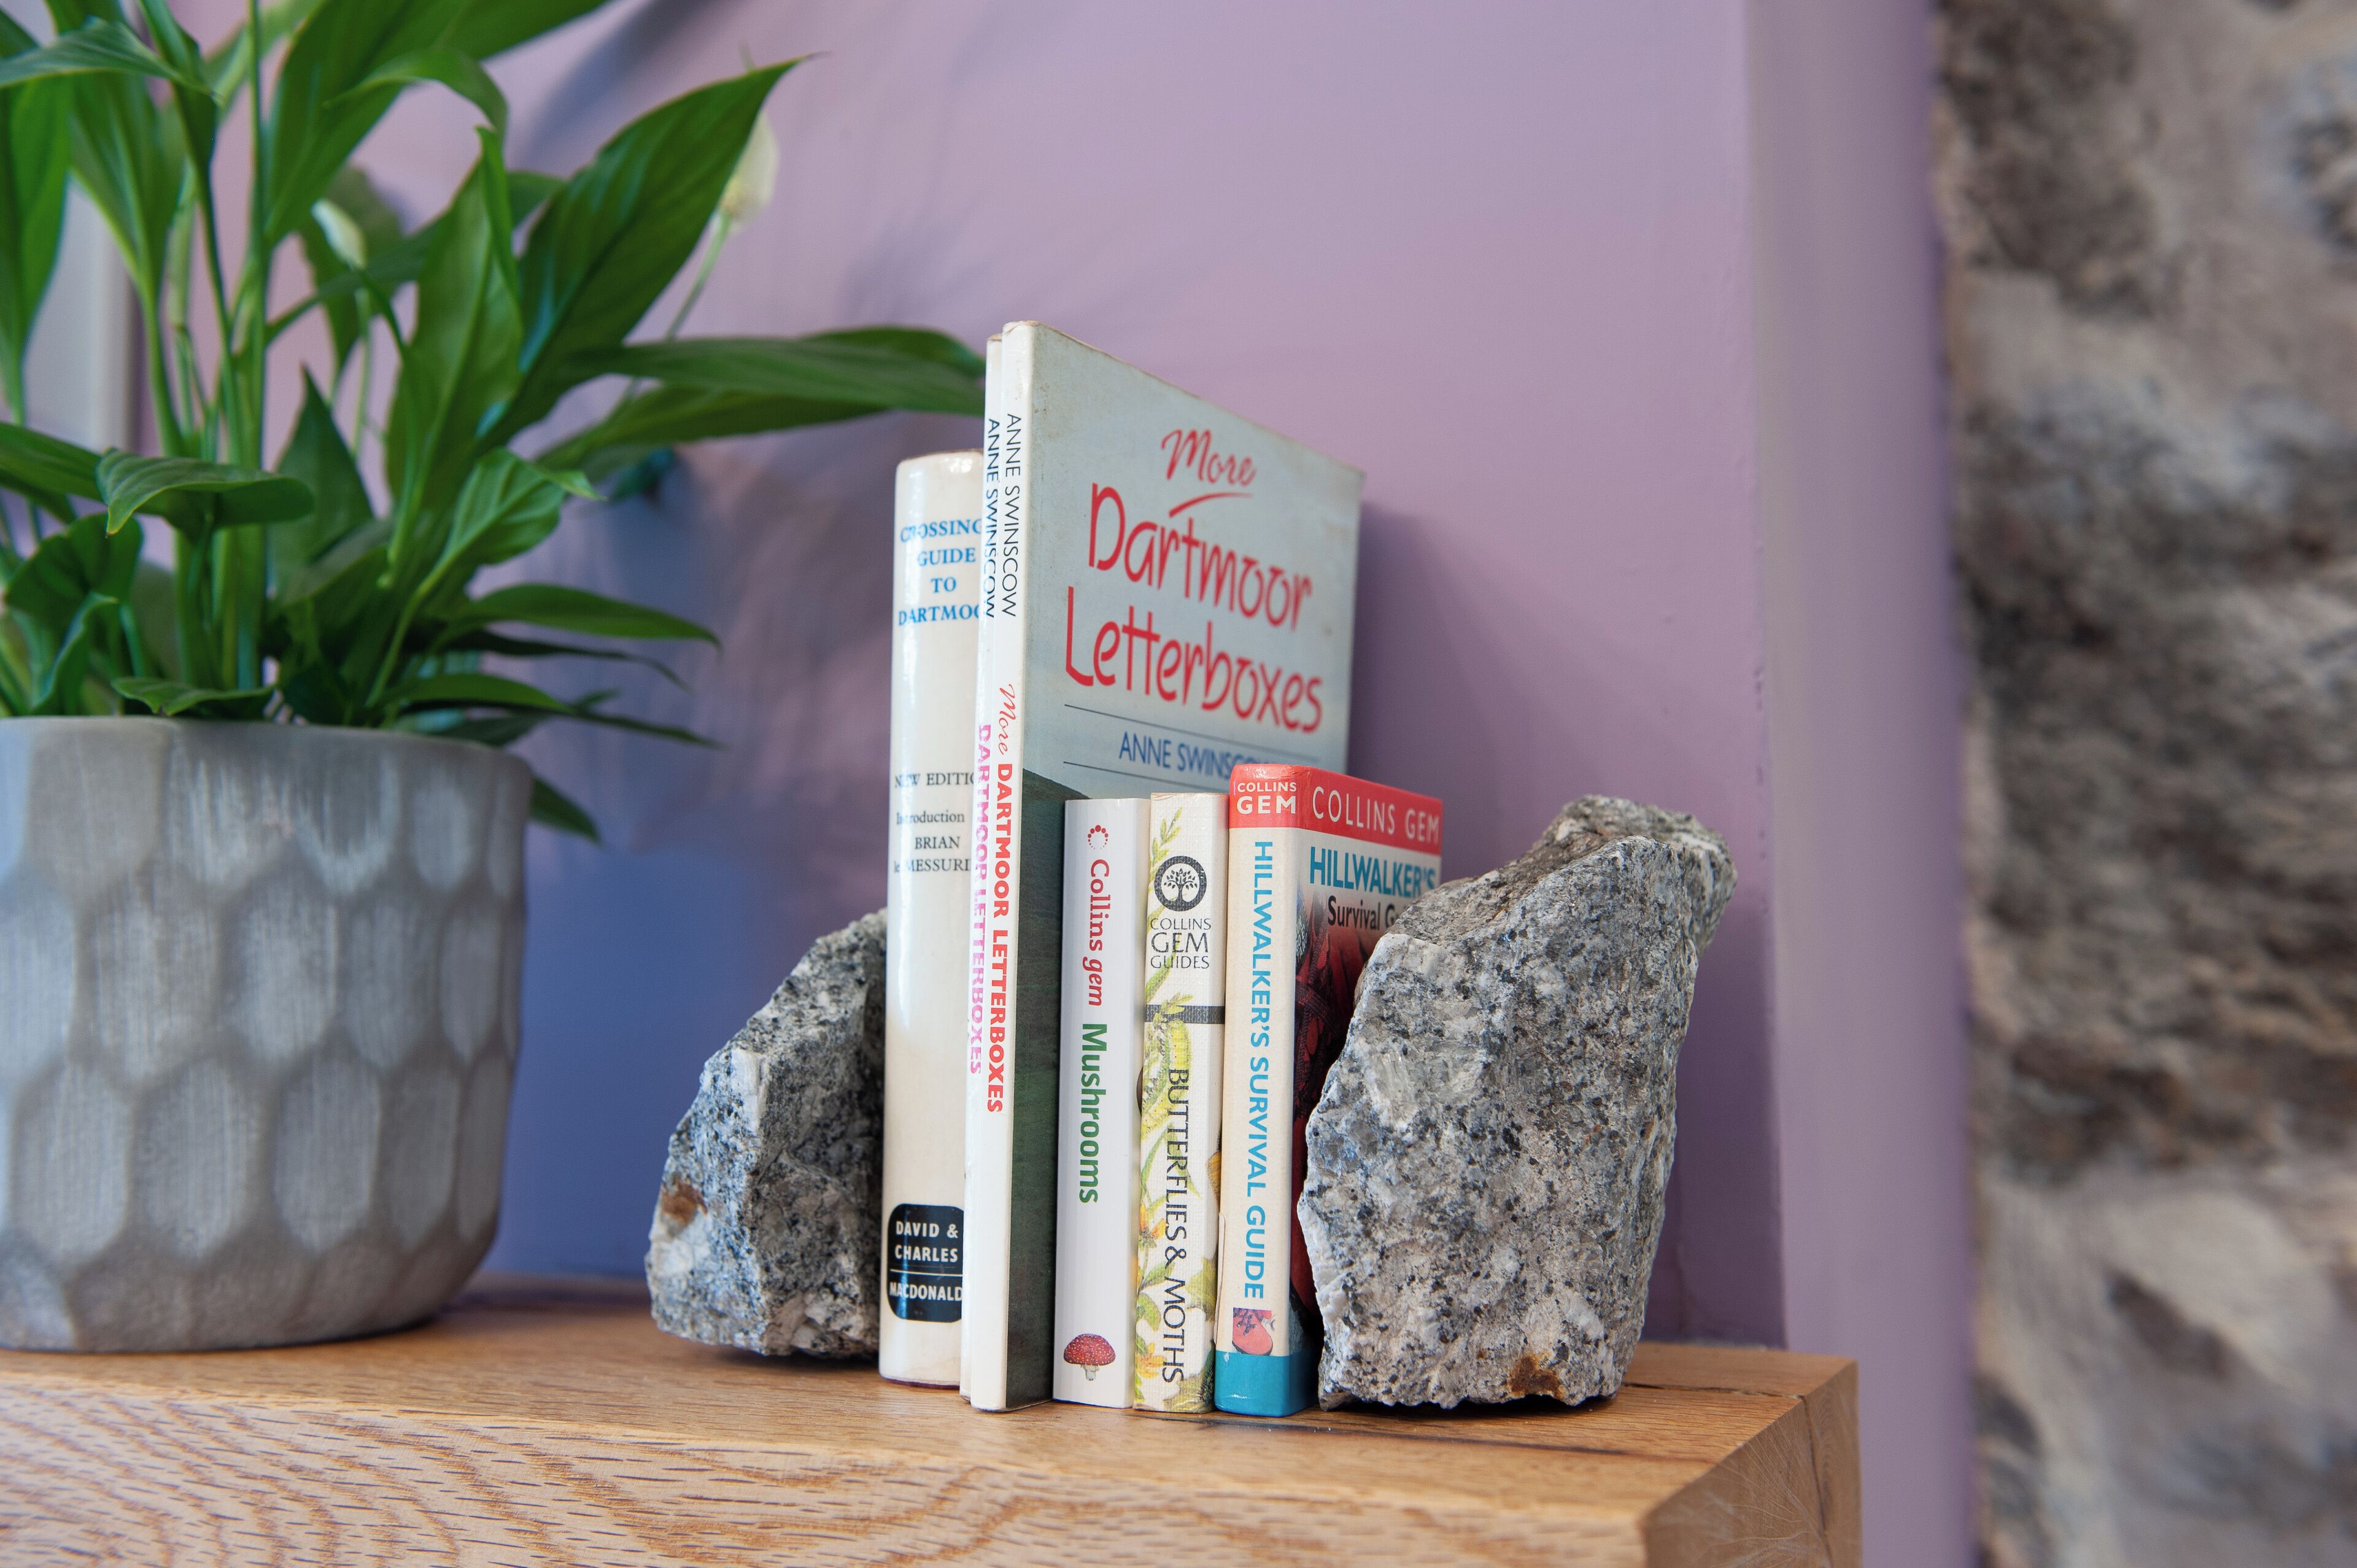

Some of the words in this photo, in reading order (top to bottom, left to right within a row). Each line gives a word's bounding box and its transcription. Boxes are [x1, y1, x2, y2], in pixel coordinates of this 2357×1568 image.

[987, 419, 1000, 482] ANNE
[1006, 414, 1021, 477] ANNE
[1161, 429, 1257, 487] More
[917, 547, 976, 566] GUIDE
[983, 489, 998, 618] SWINSCOW
[1002, 485, 1020, 617] SWINSCOW
[1089, 482, 1313, 631] Dartmoor
[931, 577, 957, 593] TO
[898, 604, 979, 626] DARTMO
[1066, 586, 1323, 734] Letterboxes
[997, 684, 1016, 755] More
[895, 773, 920, 788] NW
[926, 771, 974, 786] EDITI
[1119, 731, 1171, 768] ANNE
[1177, 743, 1264, 781] SWINS
[976, 724, 991, 880] DARTMOOR
[1237, 781, 1297, 793] COLLINS
[1237, 795, 1296, 815] GEM
[1312, 786, 1395, 835] COLLINS
[1405, 808, 1440, 846] GEM
[915, 836, 961, 849] BRIAN
[994, 763, 1013, 918] DARTMOOR
[1310, 846, 1436, 898] HILLWALKER'S
[1089, 859, 1111, 951] Collins
[1150, 918, 1212, 930] COLLINS
[1328, 895, 1381, 930] Survival
[1150, 956, 1210, 969] GUIDES
[1151, 932, 1209, 953] GEM
[1250, 841, 1273, 1048] HILLWALKER'S
[970, 889, 986, 1074] LETTERBOXES
[1082, 956, 1102, 1006] gem
[987, 929, 1008, 1113] LETTERBOXES
[1079, 1023, 1107, 1203] Mushrooms
[1247, 1057, 1269, 1198] SURVIVAL
[1164, 1068, 1189, 1241] BUTTERFLIES
[894, 1244, 958, 1263] CHARLES
[896, 1221, 940, 1238] DAVID
[946, 1223, 959, 1238] &
[1164, 1246, 1187, 1269] &
[1244, 1205, 1266, 1300] GUIDE
[890, 1281, 962, 1302] MACDONALD
[1163, 1276, 1186, 1383] MOTHS
